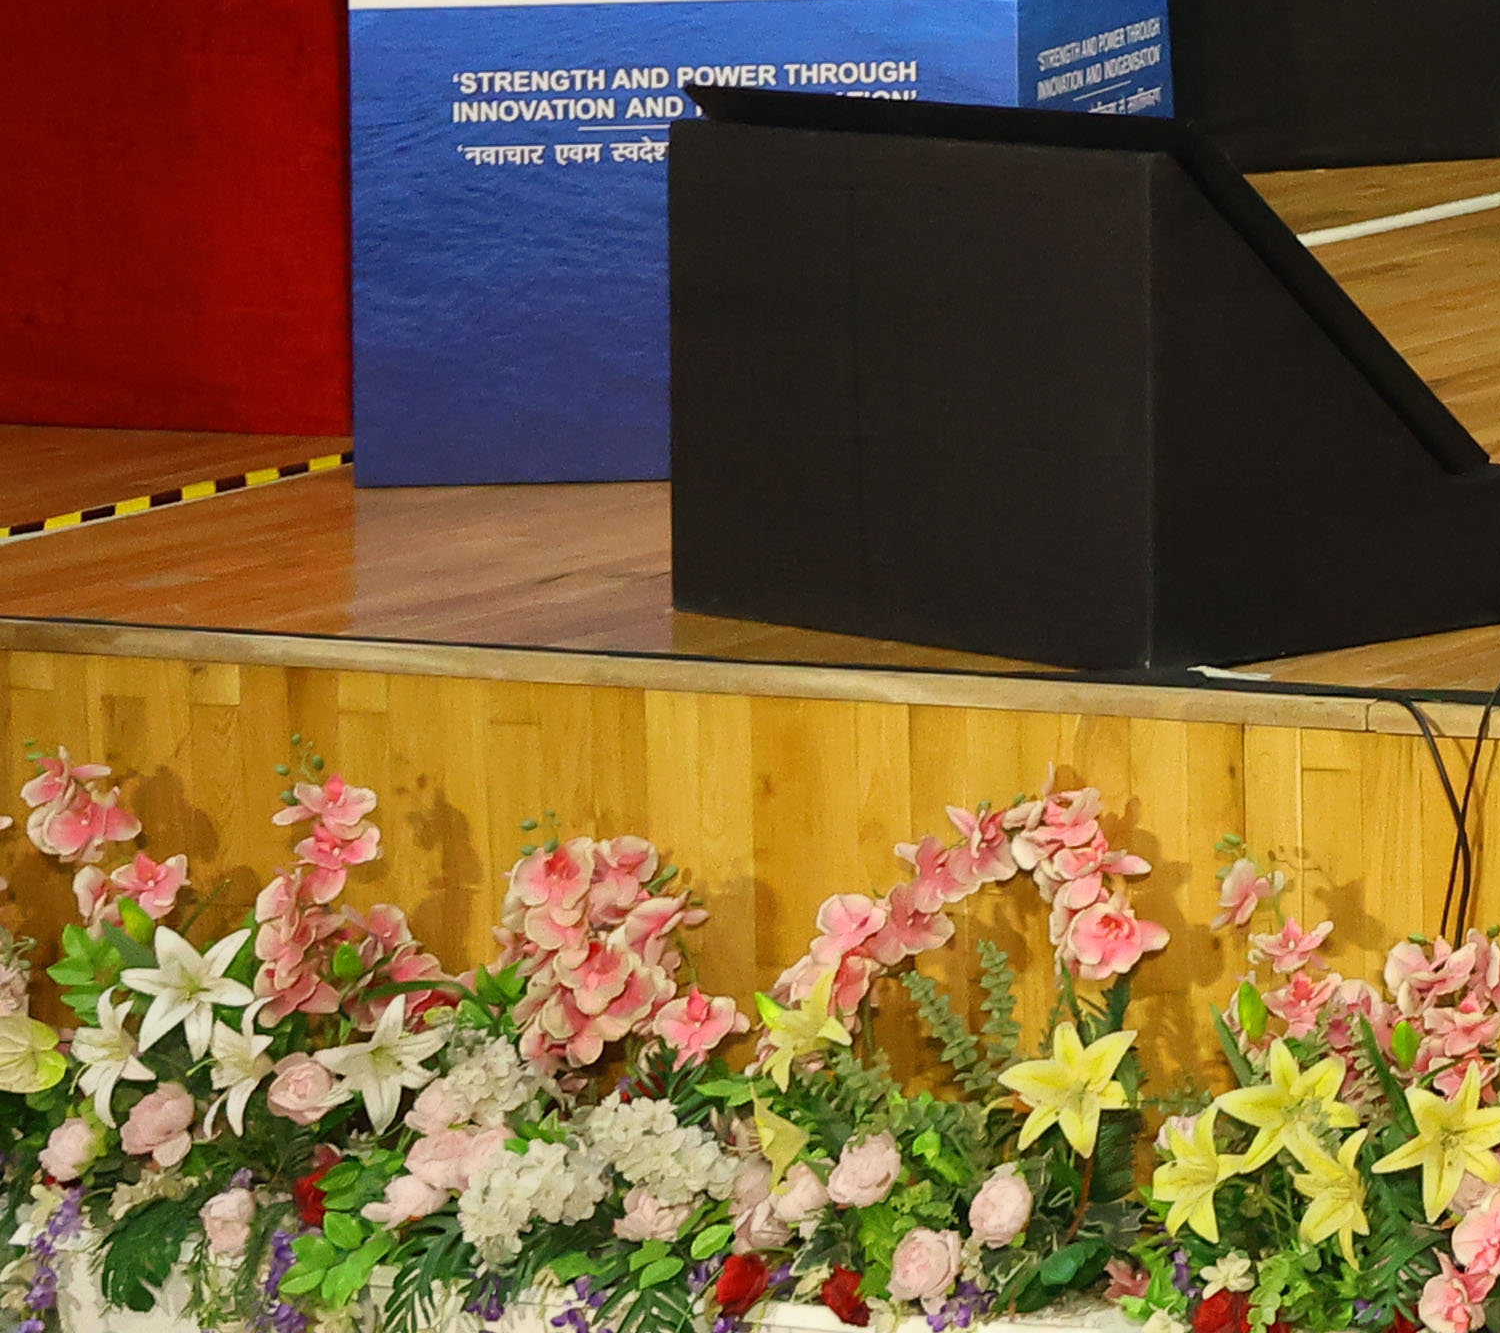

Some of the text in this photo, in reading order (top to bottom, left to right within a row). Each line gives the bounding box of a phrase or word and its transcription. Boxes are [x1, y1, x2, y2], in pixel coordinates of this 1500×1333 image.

[611, 67, 670, 91] AND
[677, 64, 777, 89] POWER
[783, 60, 917, 86] THROUGH
[452, 97, 615, 124] INNOVATION
[626, 95, 684, 119] AND
[553, 142, 604, 166] एवम
